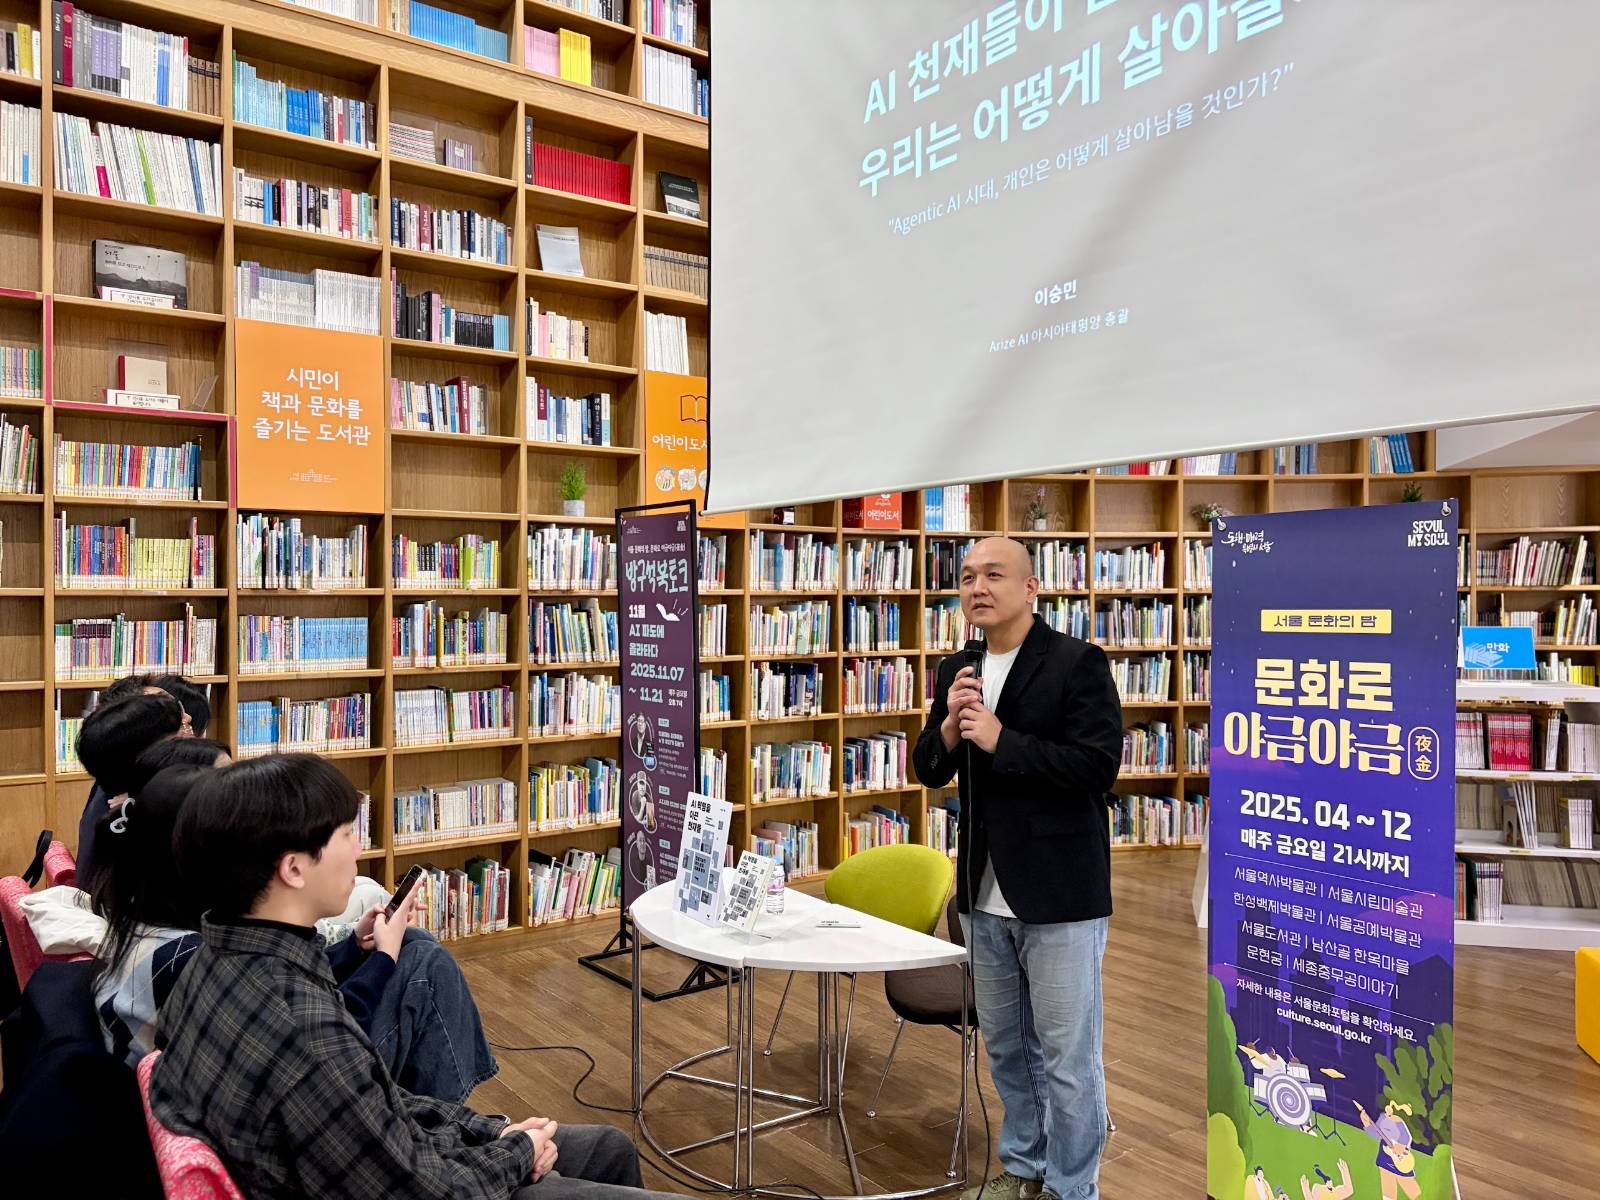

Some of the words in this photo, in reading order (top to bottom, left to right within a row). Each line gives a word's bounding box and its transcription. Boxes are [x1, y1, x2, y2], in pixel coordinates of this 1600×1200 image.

[863, 69, 896, 124] AI
[907, 0, 1063, 103] 천재들이
[858, 121, 961, 197] 우리는
[973, 41, 1101, 144] 어떻게
[888, 203, 944, 236] "Agentic
[946, 193, 961, 214] AI
[964, 177, 999, 205] 시대,
[1003, 158, 1051, 192] 개인은
[1056, 135, 1108, 170] 어떻게
[1115, 102, 1195, 152] 살아남을
[1201, 62, 1294, 120] 것인가?"
[1034, 280, 1077, 306] 이승민
[989, 338, 1016, 353] Arize
[1017, 332, 1029, 346] AI
[1031, 314, 1101, 343] 아시아태평양
[286, 367, 340, 391] 시민이
[261, 391, 302, 414] 책과
[307, 395, 364, 420] 문화를
[252, 417, 311, 442] 즐기는
[316, 423, 371, 446] 도서관
[651, 433, 707, 451] 어린이도
[867, 509, 900, 521] 어린이도서
[1412, 519, 1445, 534] SEOUL
[1423, 532, 1450, 547] SOUL
[628, 604, 646, 619] 11월
[1274, 614, 1303, 628] 서울
[1308, 614, 1355, 628] 문화의
[1360, 614, 1377, 629] 밤
[628, 623, 641, 637] AI
[642, 623, 665, 639] 파도에
[1486, 642, 1511, 654] 만화
[629, 642, 659, 658] 올라타다
[630, 662, 685, 682] 2025.11.07
[1254, 658, 1394, 712] 문화로
[640, 686, 664, 703] 11.21
[1223, 711, 1406, 776] 야금야금
[1414, 734, 1433, 773] 夜金
[1240, 789, 1309, 825] 2025.
[1315, 800, 1350, 830] 04
[1381, 809, 1412, 841] 12
[1240, 828, 1273, 851] 매주
[1276, 834, 1326, 862] 금요일
[1333, 843, 1410, 878] 21시까지
[1234, 866, 1317, 897] 서울역사박물관
[1328, 886, 1424, 920] 서울시립미술관
[1233, 892, 1317, 923] 한성백제박물관
[1327, 913, 1422, 949] 서울공예박물관
[1241, 920, 1302, 948] 서울도서관
[1312, 937, 1351, 961] 남산골
[1353, 948, 1410, 976] 한옥마을
[1247, 945, 1283, 967] 운현궁
[1293, 957, 1400, 1000] 세종충무공이야기
[1236, 978, 1263, 996] 자세한
[1265, 986, 1292, 1004] 내용은
[1293, 995, 1361, 1026] 서울문화포털을
[1362, 1015, 1418, 1043] 확인하세요.
[1276, 1006, 1373, 1045] culture.seoul.go.kr
